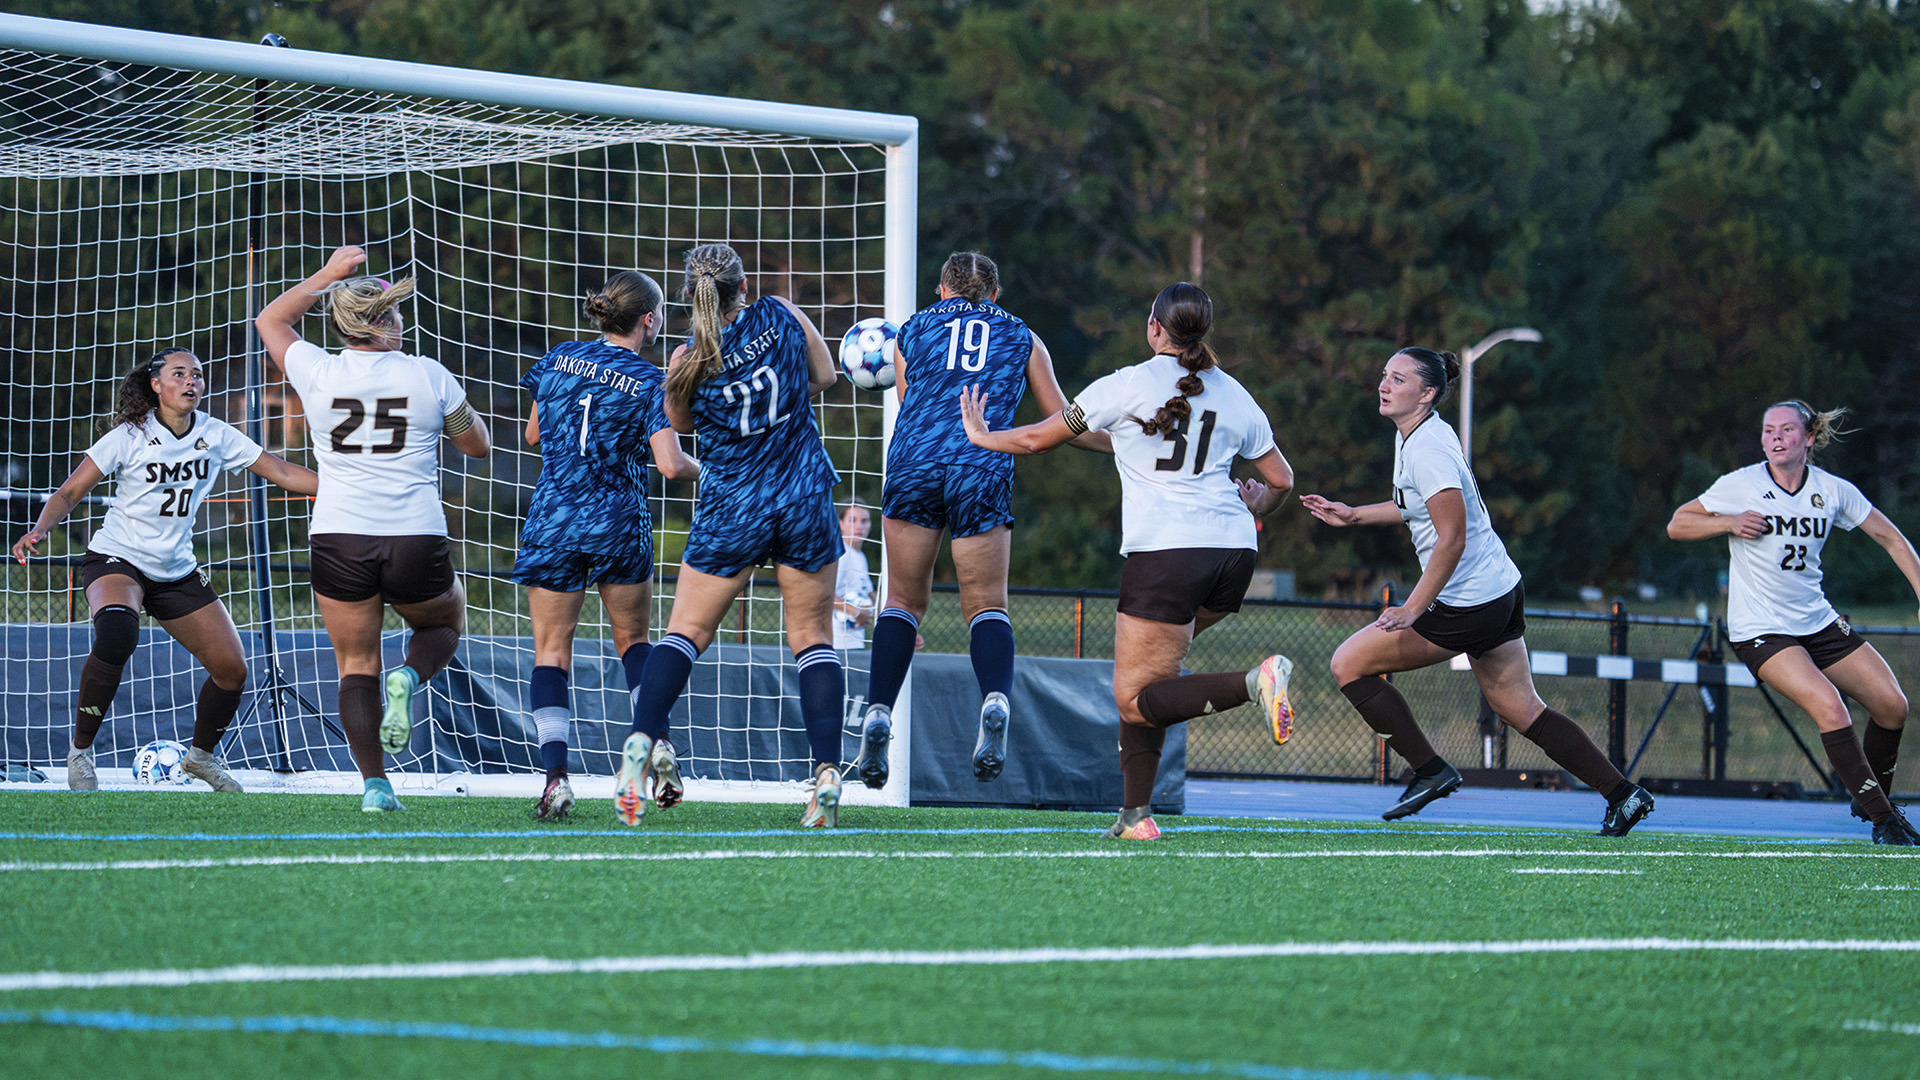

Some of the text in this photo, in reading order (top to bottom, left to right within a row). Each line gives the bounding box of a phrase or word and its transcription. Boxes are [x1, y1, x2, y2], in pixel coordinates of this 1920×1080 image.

[743, 326, 780, 360] STATE
[944, 318, 990, 372] 19
[553, 355, 643, 397] DAKOTA STATE
[723, 365, 790, 438] 22
[330, 397, 408, 454] 25
[578, 393, 593, 456] 1
[1154, 408, 1217, 476] 31
[145, 458, 210, 484] SMSU
[159, 488, 193, 517] 20
[1762, 515, 1827, 538] SMSU
[1780, 544, 1808, 571] 23
